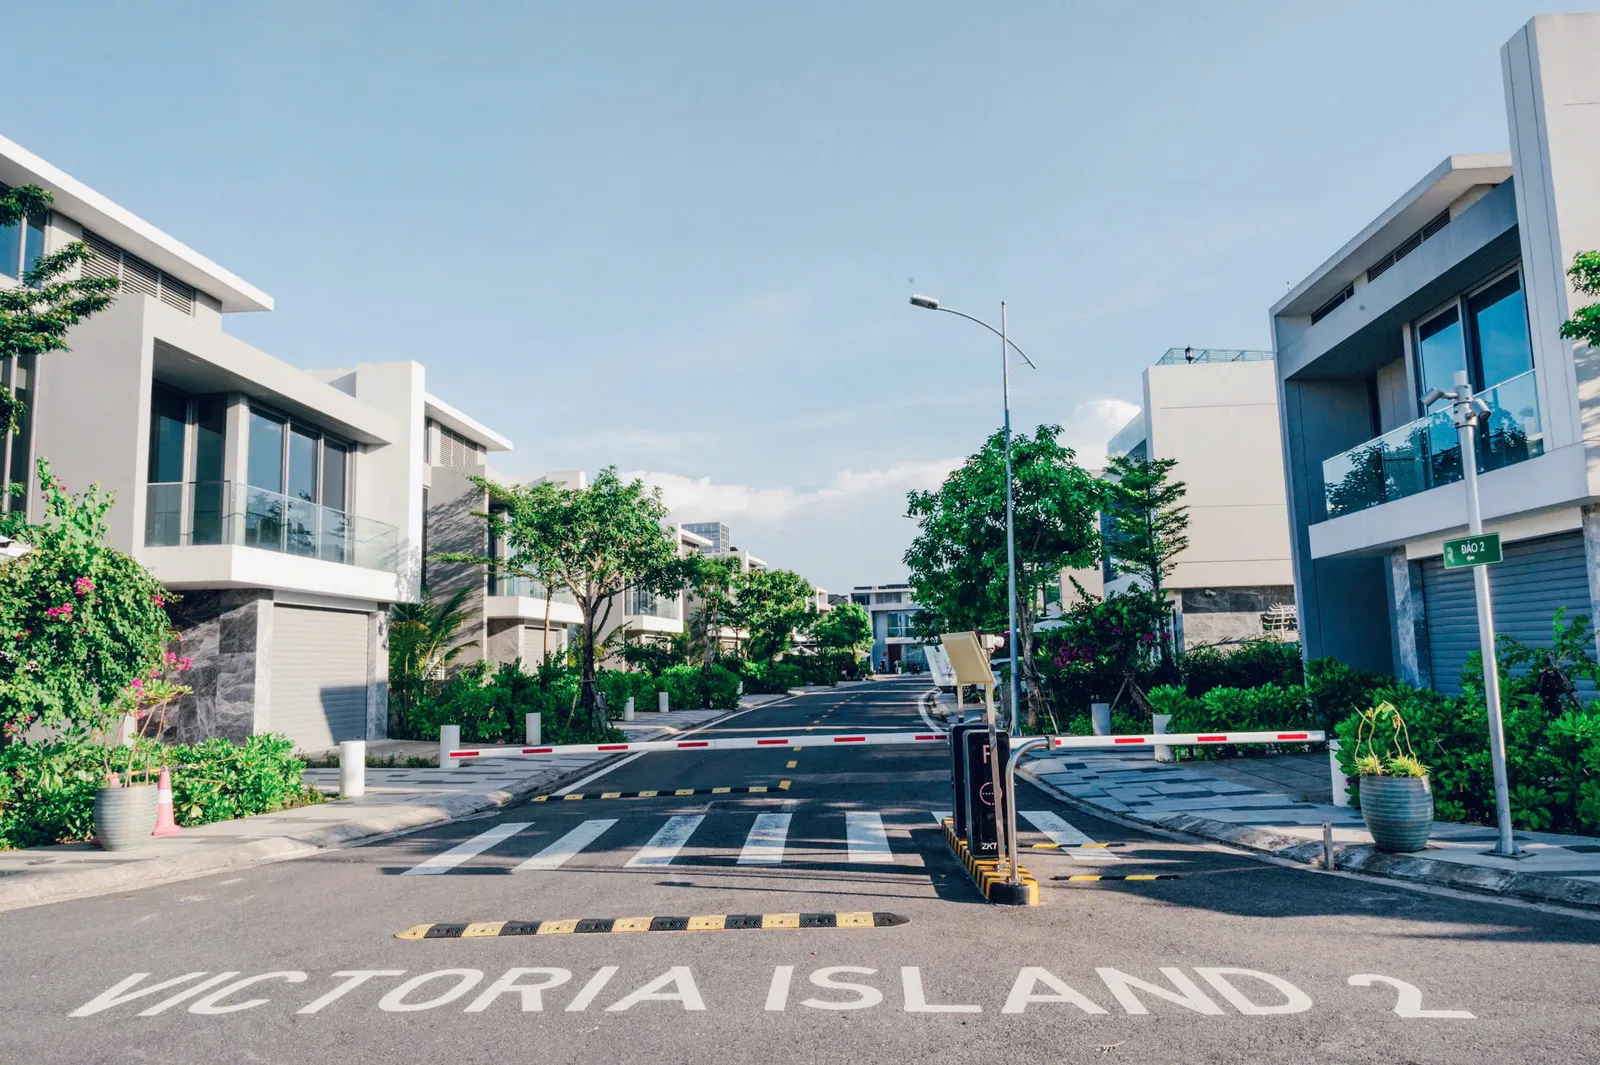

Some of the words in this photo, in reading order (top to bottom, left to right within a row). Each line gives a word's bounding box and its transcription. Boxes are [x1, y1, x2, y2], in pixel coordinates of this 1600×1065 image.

[1461, 541, 1478, 554] ĐẢO
[1479, 541, 1485, 552] 2
[67, 964, 707, 1018] VICTORIA
[763, 964, 1314, 1018] ISLAND
[1346, 966, 1479, 1022] 2
